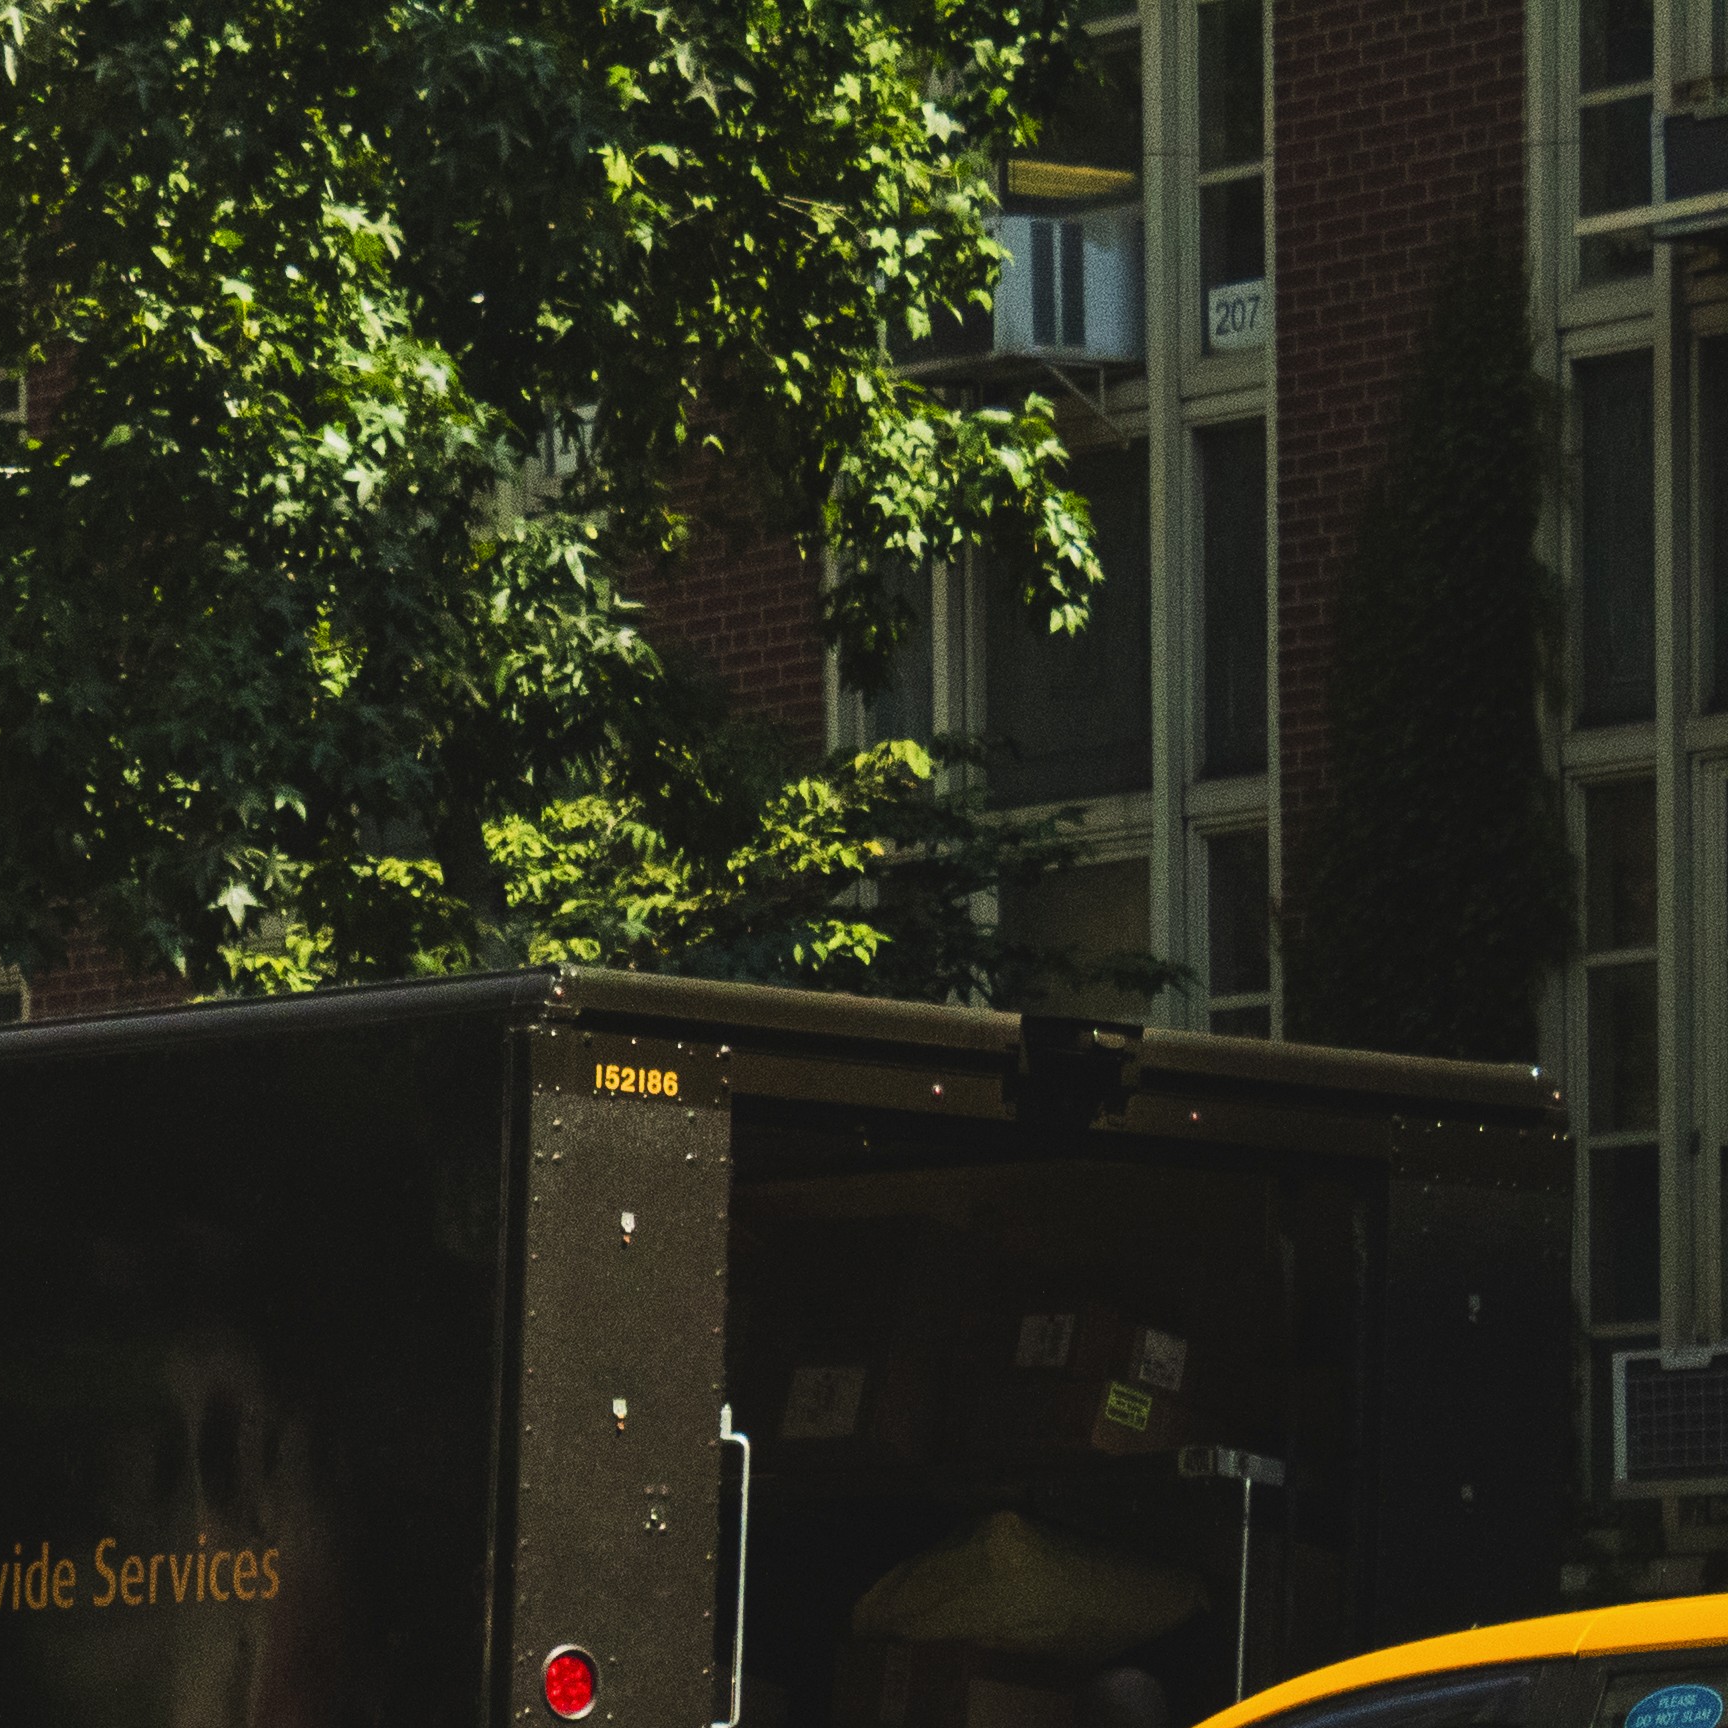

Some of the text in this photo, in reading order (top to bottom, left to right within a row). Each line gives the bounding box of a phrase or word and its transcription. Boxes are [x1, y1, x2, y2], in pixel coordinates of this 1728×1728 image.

[1215, 293, 1261, 336] 207
[595, 1063, 678, 1097] 152186
[93, 1533, 280, 1608] Services
